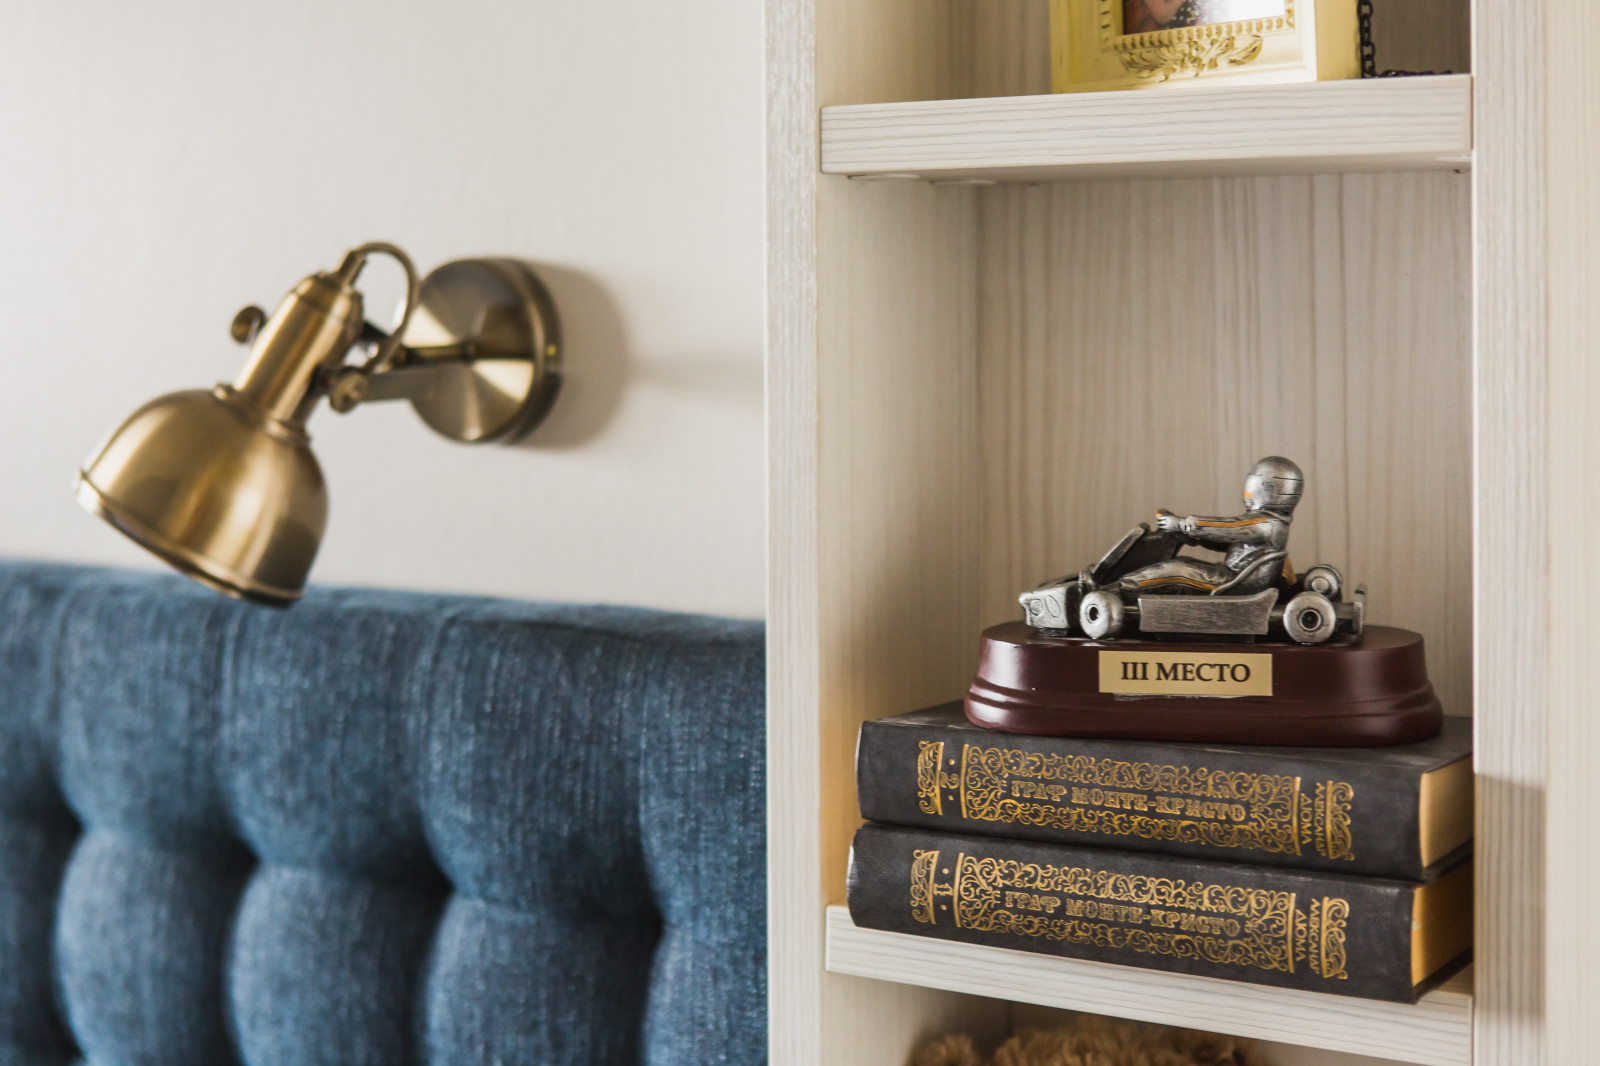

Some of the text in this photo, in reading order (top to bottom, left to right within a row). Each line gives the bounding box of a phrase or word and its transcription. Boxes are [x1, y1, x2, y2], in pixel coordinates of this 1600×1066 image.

[1120, 661, 1251, 683] III МЕСТО
[1011, 780, 1246, 822] ГРАФ МОНТЕ-КРИСТО
[1300, 792, 1312, 845] ДЮМА
[1005, 890, 1241, 937] ГРАФ МОНТЕ-КРИСТО
[1294, 908, 1307, 962] ДЮМА
